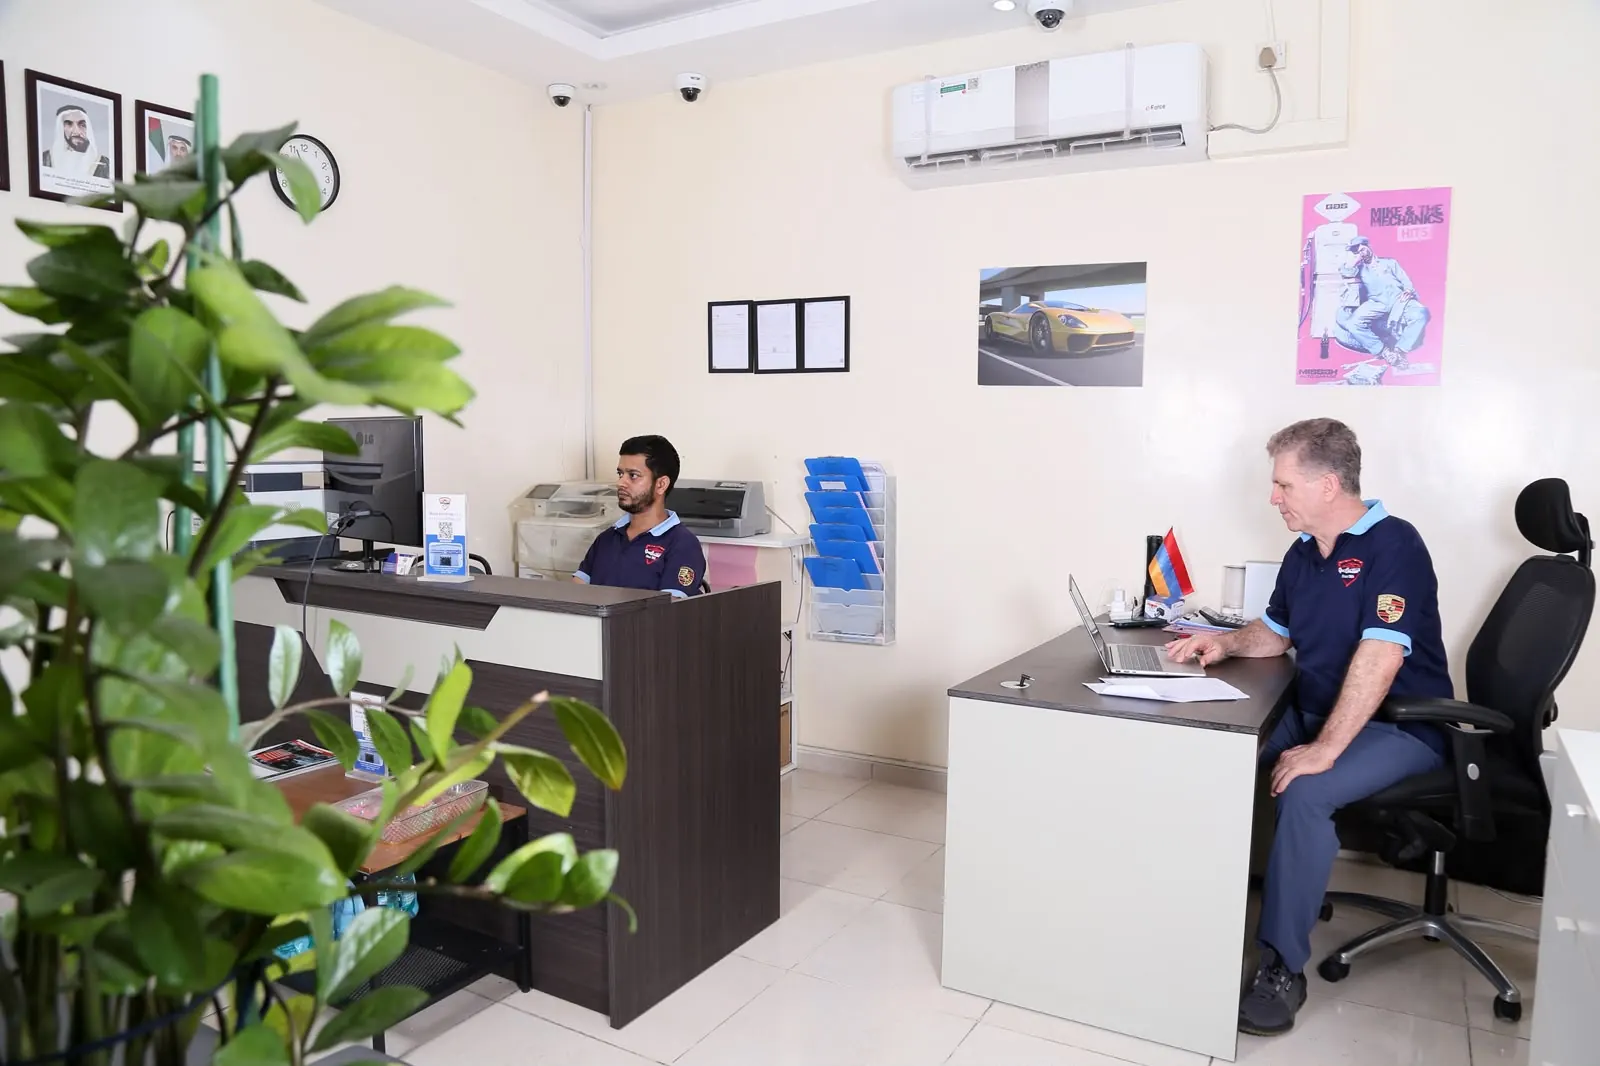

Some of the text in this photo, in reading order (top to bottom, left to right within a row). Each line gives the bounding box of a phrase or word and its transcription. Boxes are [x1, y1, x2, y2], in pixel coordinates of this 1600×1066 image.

[289, 144, 296, 154] 11
[300, 143, 309, 153] 12
[321, 162, 327, 171] 2
[281, 179, 288, 188] 8
[324, 175, 331, 184] 3
[1370, 204, 1444, 219] MIKE & THE
[1370, 212, 1445, 228] MECHANICS
[1401, 226, 1428, 240] HITS
[364, 433, 375, 445] LG
